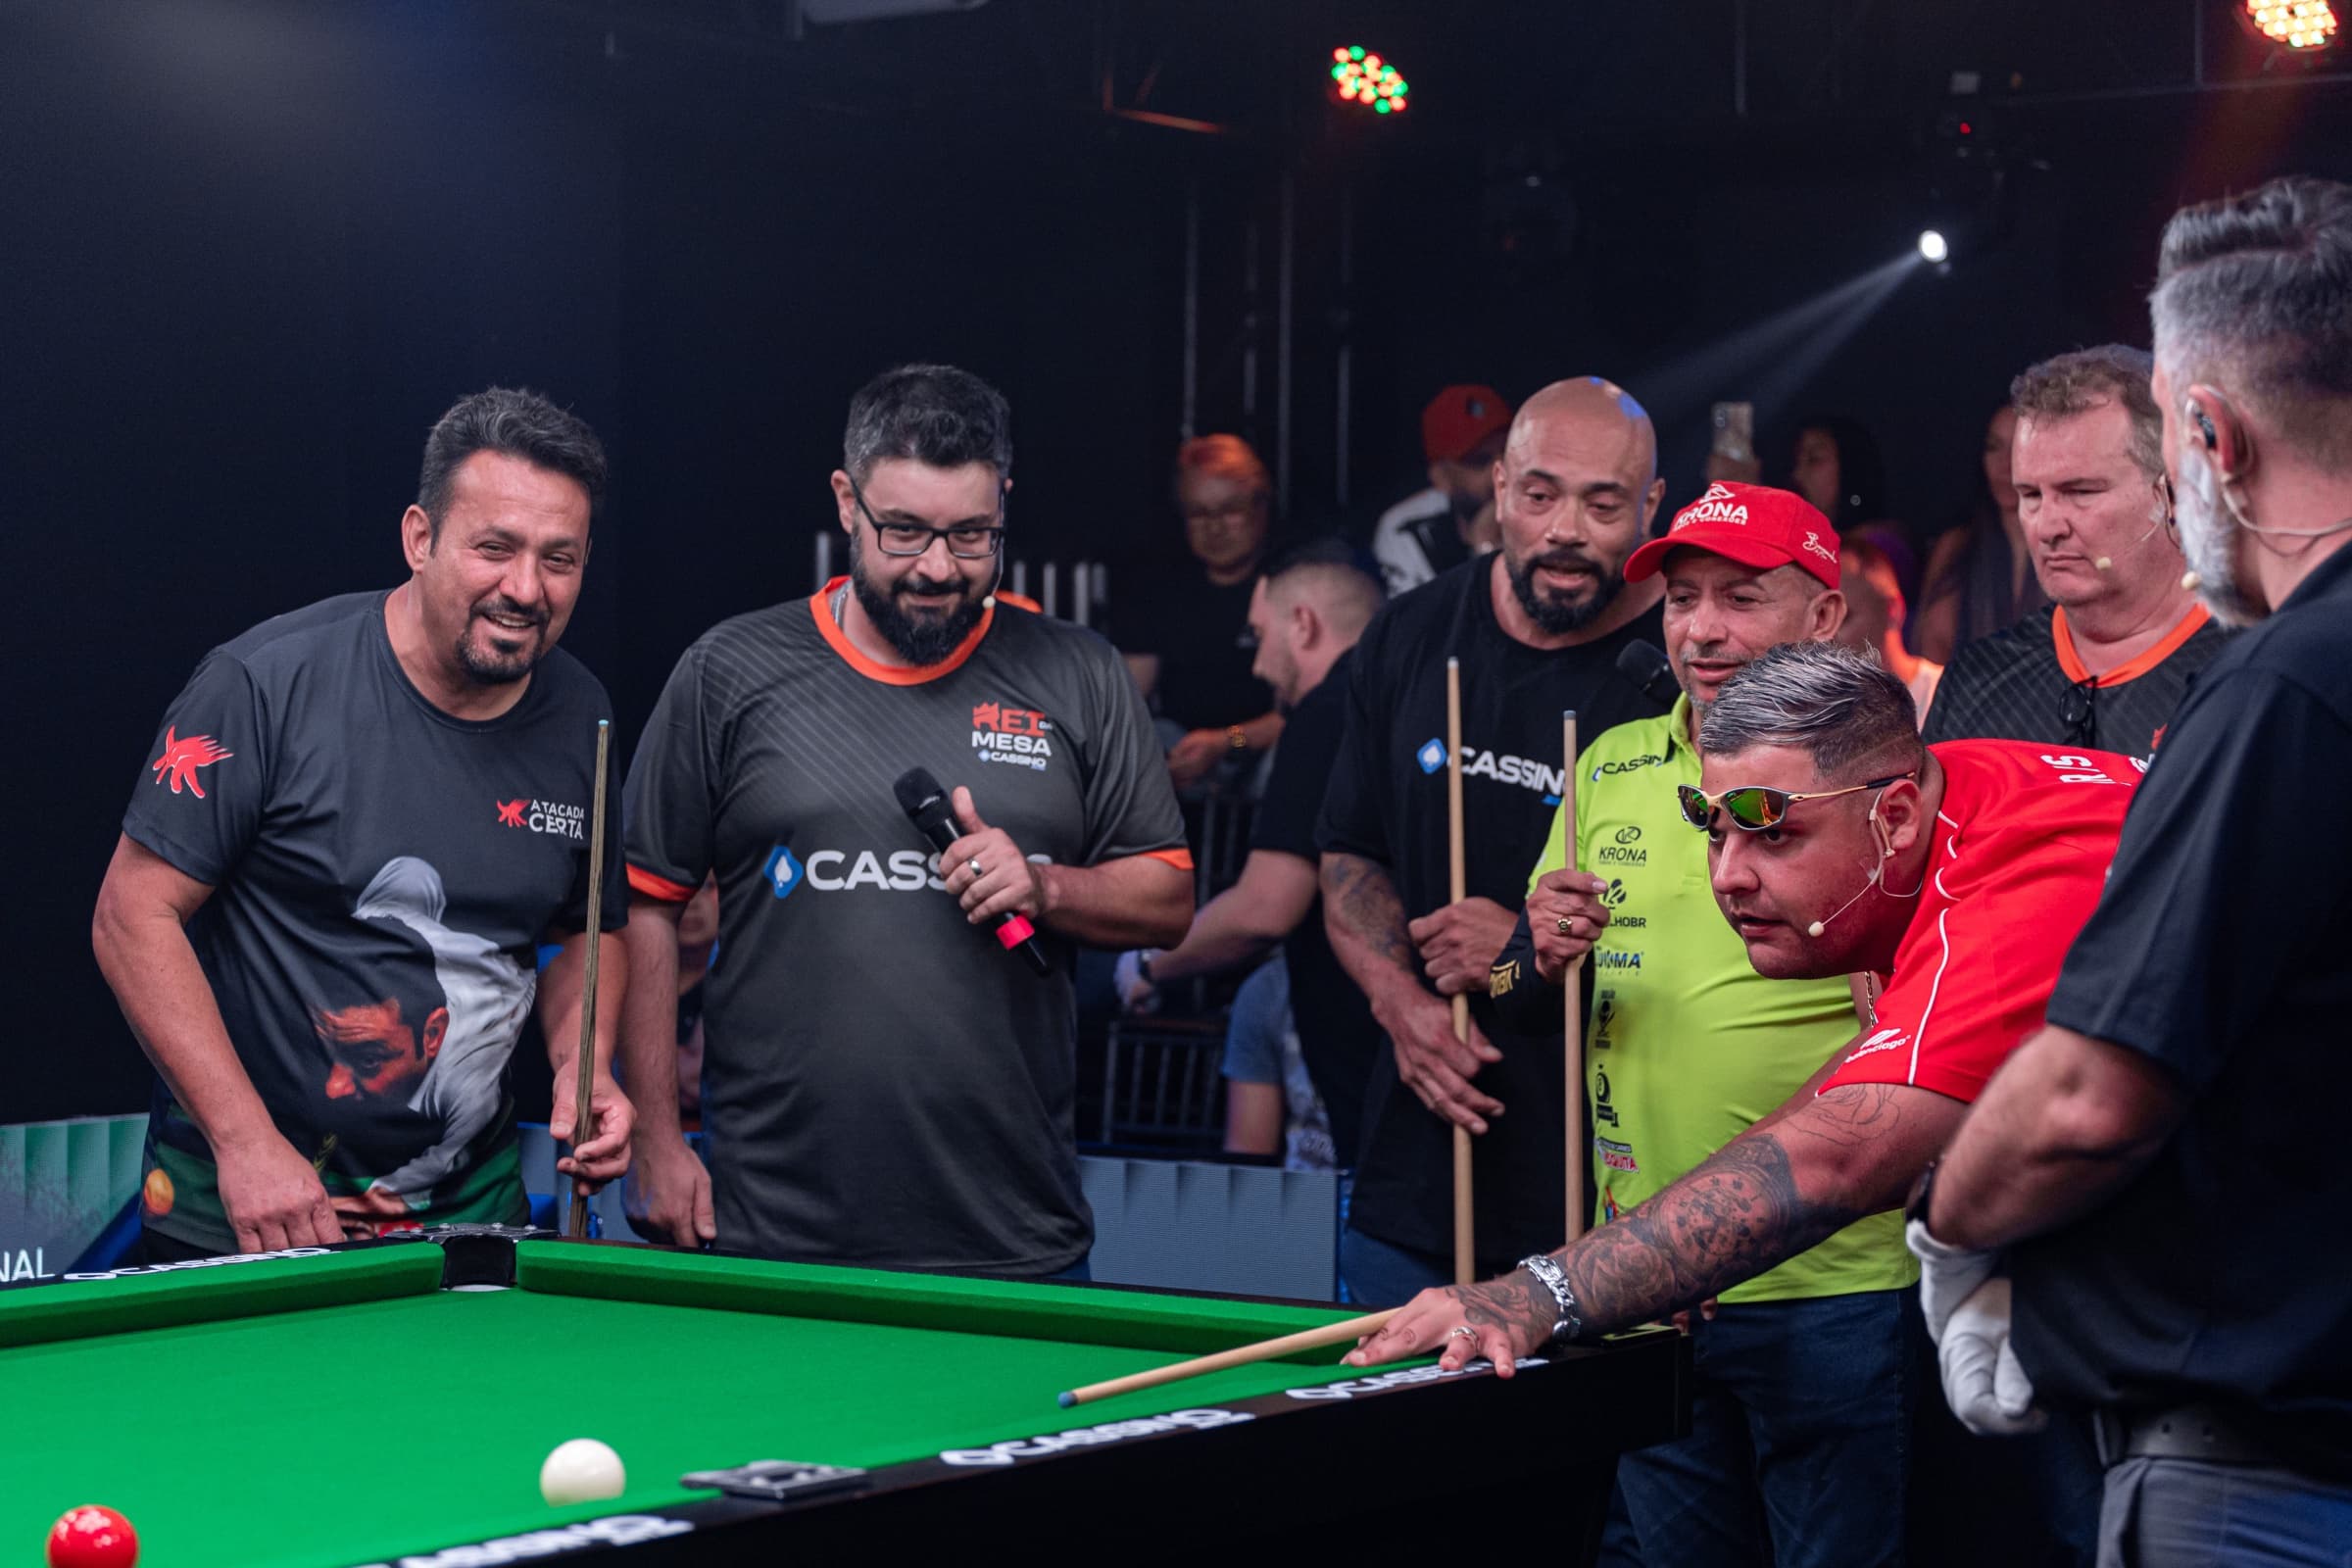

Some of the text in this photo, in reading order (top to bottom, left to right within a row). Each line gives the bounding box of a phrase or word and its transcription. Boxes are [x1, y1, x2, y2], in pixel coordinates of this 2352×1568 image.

[972, 702, 1045, 737] REI
[972, 730, 1052, 757] MESA
[1447, 746, 1565, 796] CASSIN
[1602, 754, 1662, 774] CASSIN
[530, 799, 585, 820] ATACADA
[529, 812, 583, 840] CERTA
[1598, 847, 1646, 862] KRONA
